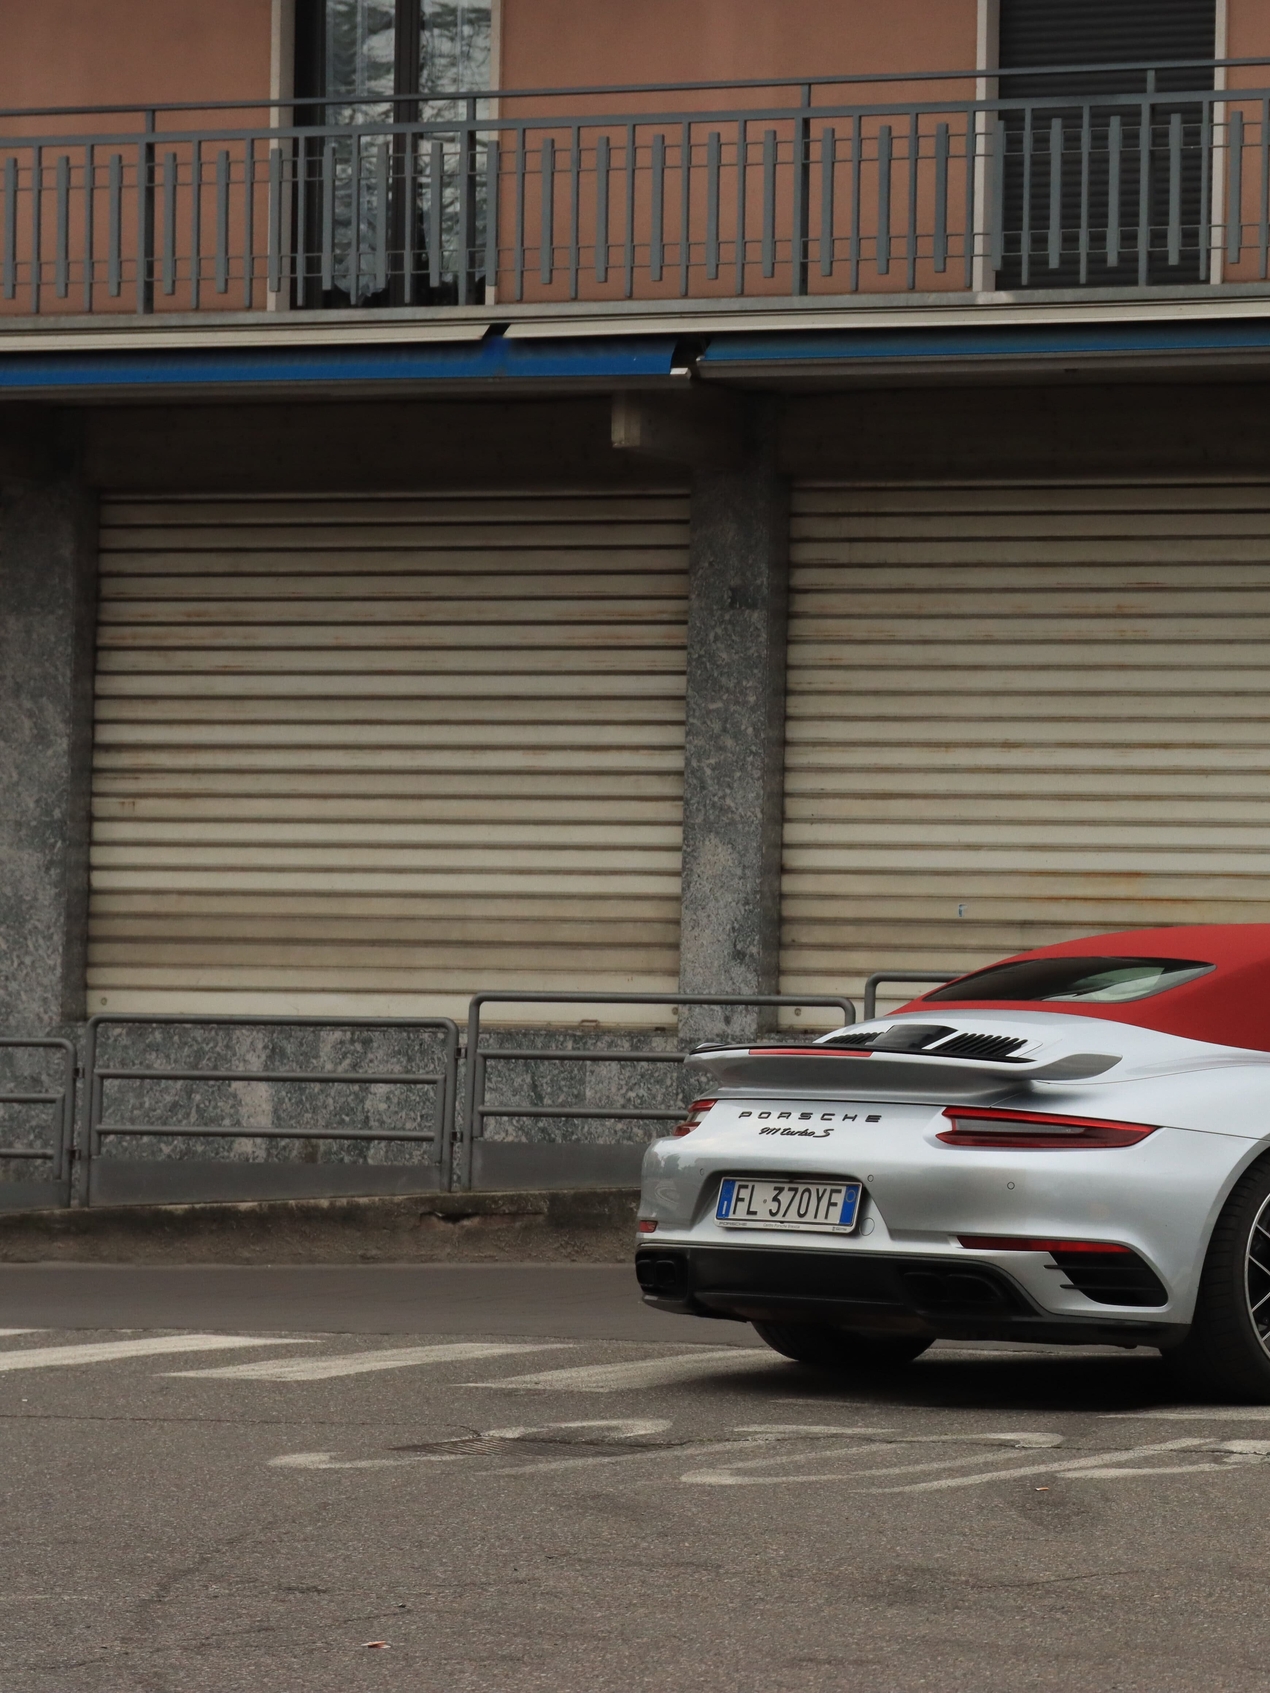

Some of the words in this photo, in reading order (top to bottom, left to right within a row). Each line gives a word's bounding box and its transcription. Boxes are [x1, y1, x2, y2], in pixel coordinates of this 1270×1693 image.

[738, 1111, 882, 1123] PORSCHE
[780, 1127, 815, 1137] turbo
[813, 1128, 834, 1138] S
